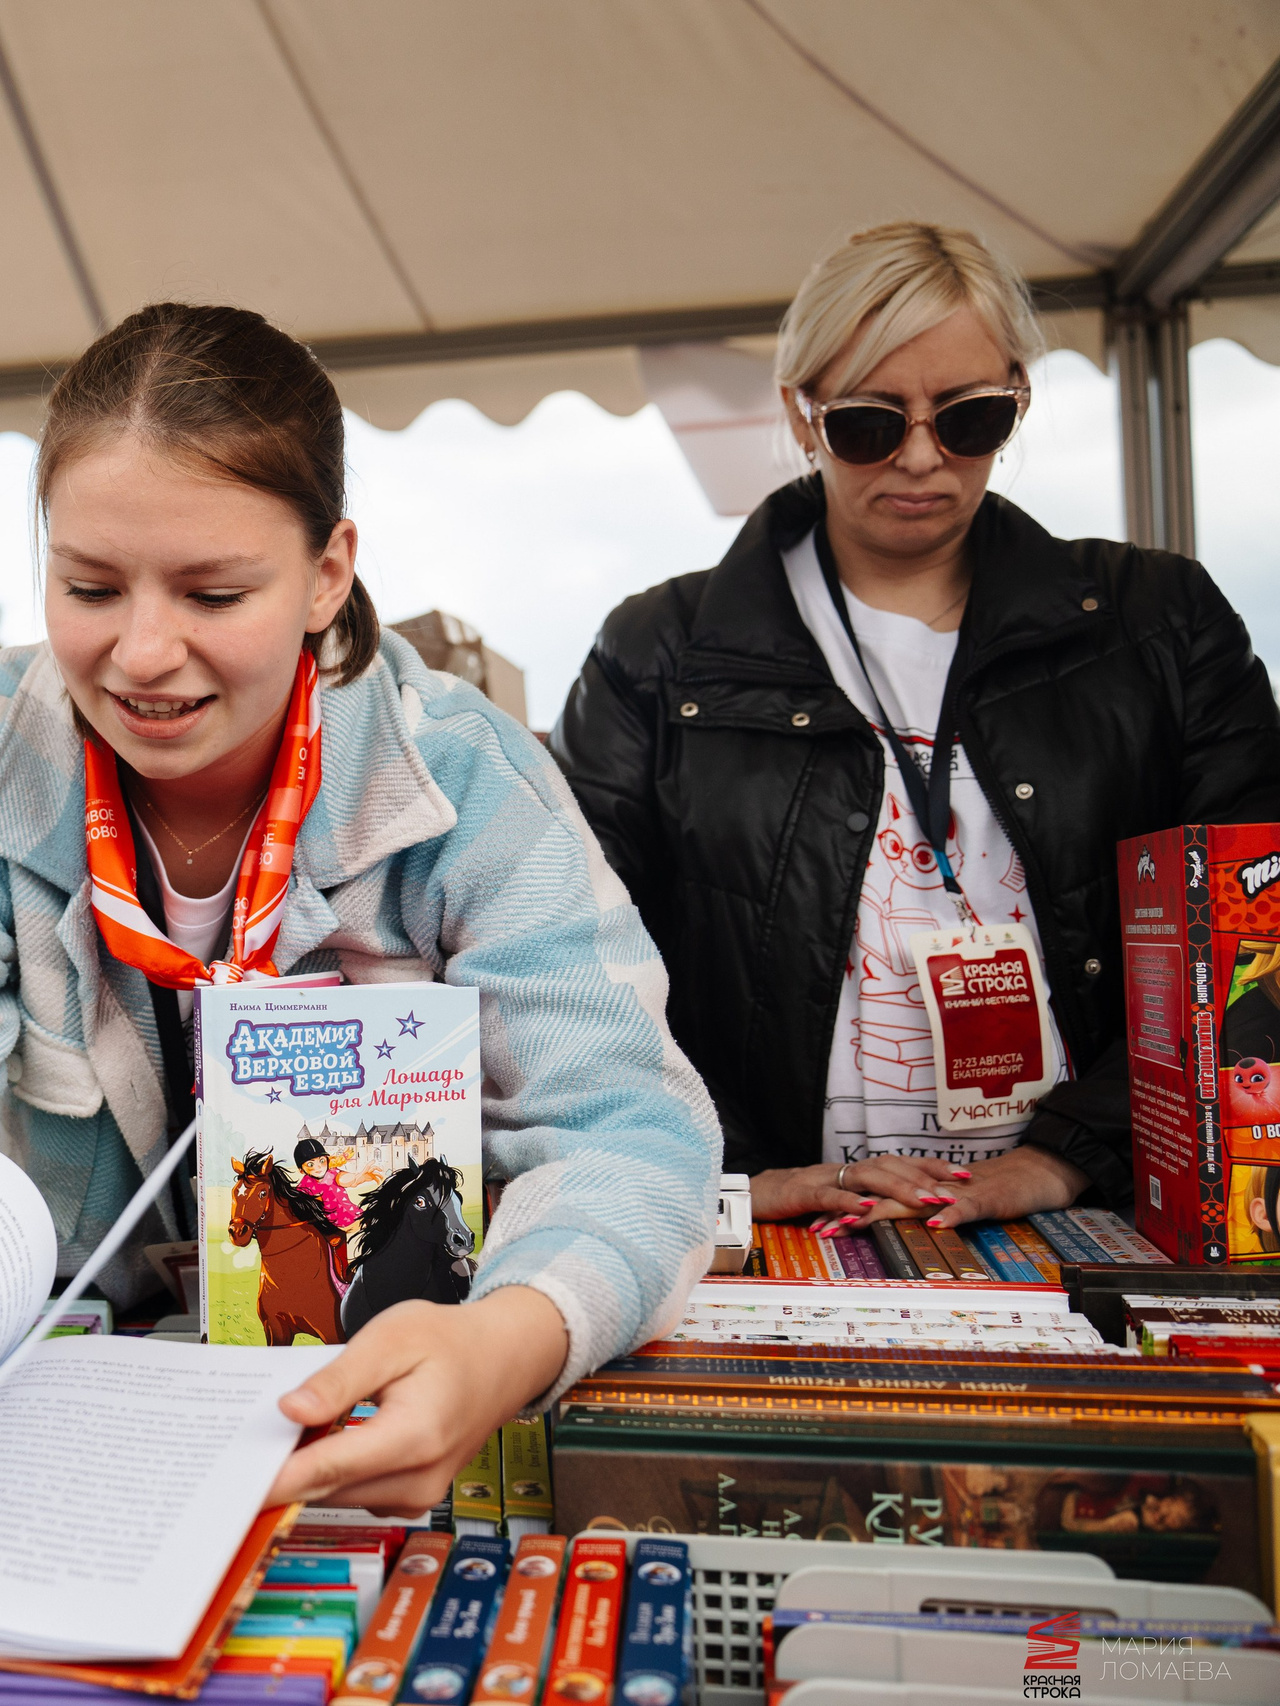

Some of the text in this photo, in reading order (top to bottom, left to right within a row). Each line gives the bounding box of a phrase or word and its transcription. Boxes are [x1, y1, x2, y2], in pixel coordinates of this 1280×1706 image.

[963, 961, 1024, 979] КРАСНАЯ
[967, 975, 1028, 994] СТРОКА
[944, 993, 1031, 1009] КНИЖНЫЙ ФЕСТИВАЛЬ
[231, 1023, 359, 1057] АКАДЕМИЯ
[1195, 961, 1217, 1099] БОЛЬШАЯ ЭНЦИКЛОПЕДИЯ
[236, 1050, 356, 1080] ВЕРХОВОЙ
[952, 1053, 1024, 1069] 21-23 АВГУСТА
[952, 1063, 1024, 1080] ЕКАТЕРИНБУРГ
[295, 1070, 360, 1093] ЕЗДЫ
[382, 1067, 465, 1088] Лошадь
[328, 1087, 468, 1117] для Марьяны
